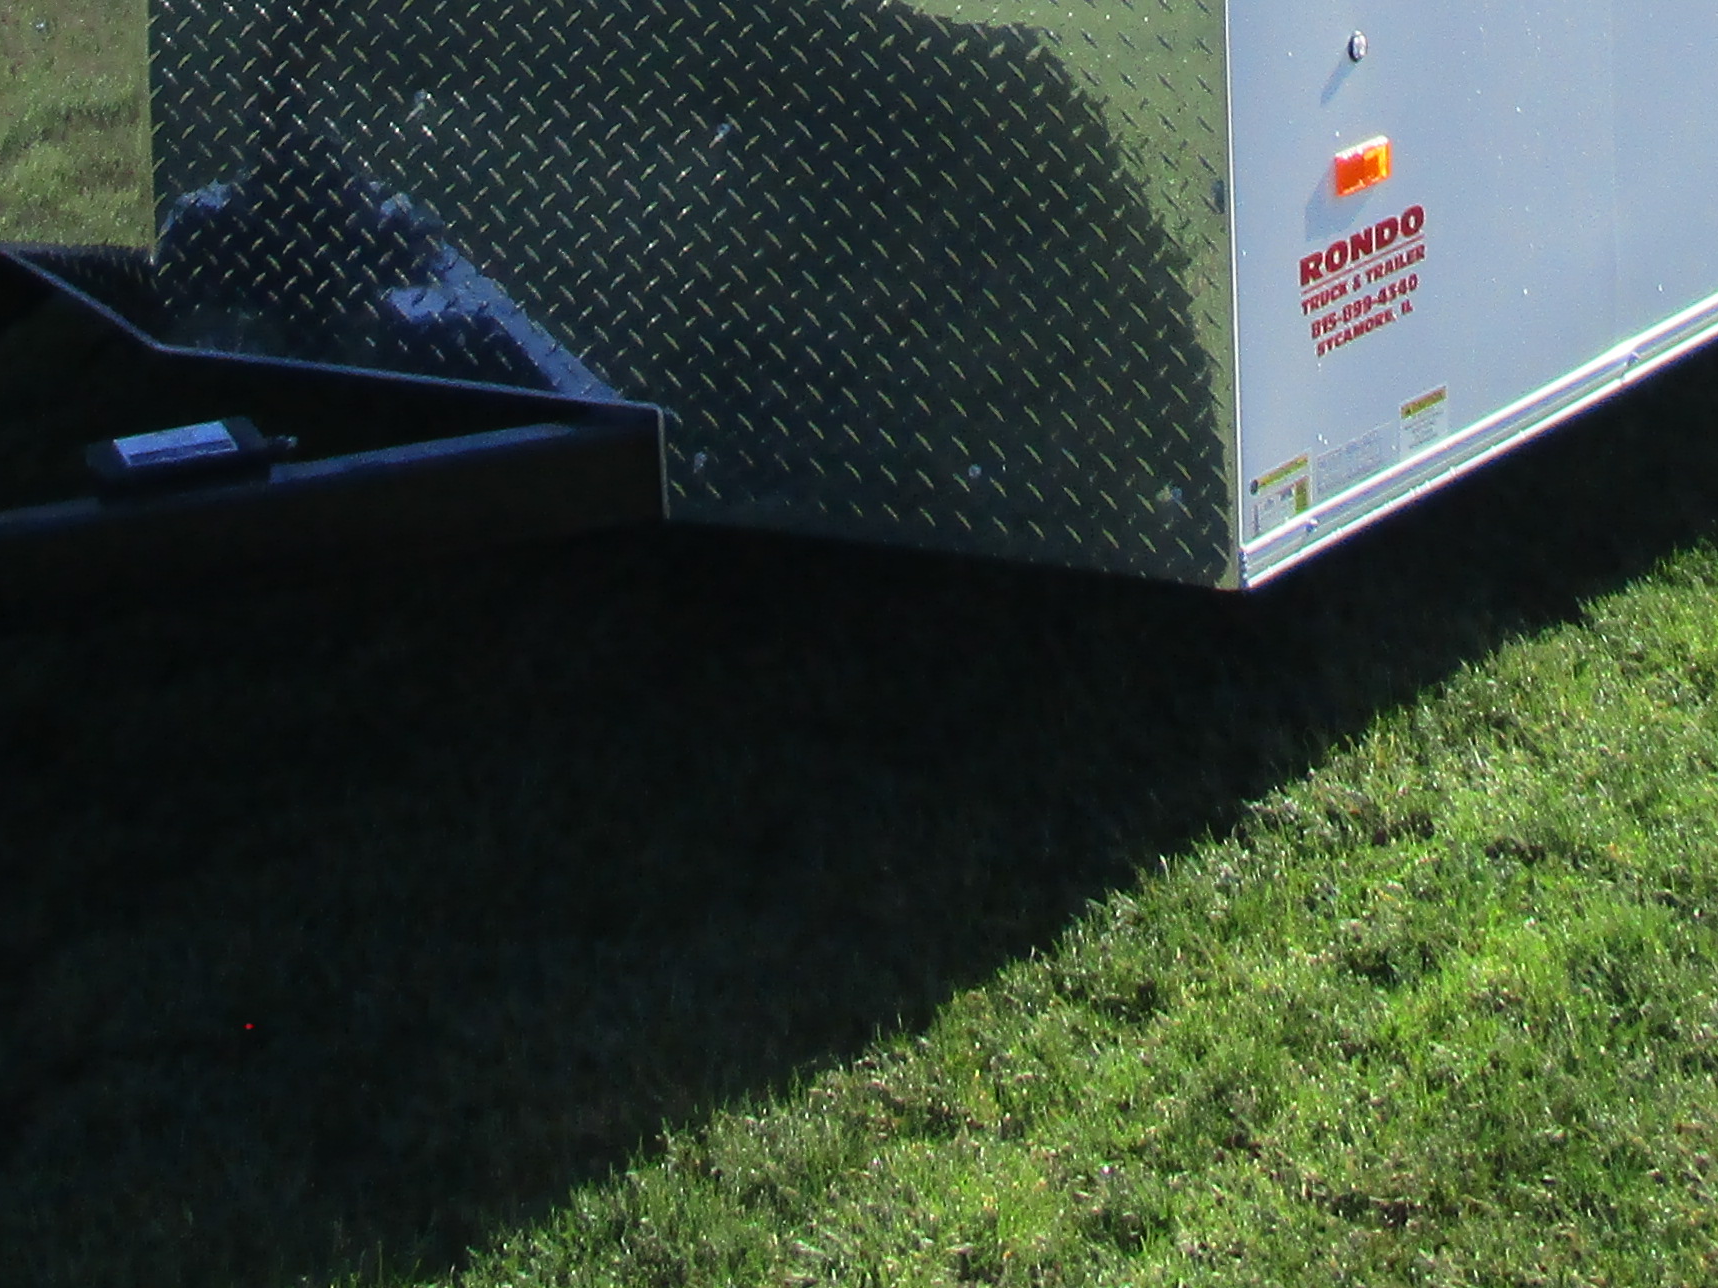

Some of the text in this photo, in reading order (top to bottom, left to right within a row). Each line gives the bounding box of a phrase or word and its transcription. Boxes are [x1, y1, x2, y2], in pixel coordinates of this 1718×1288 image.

[1300, 204, 1425, 286] RONDO
[1301, 281, 1348, 316] TRUCK
[1365, 244, 1425, 283] TRAILER
[1401, 299, 1414, 315] IL
